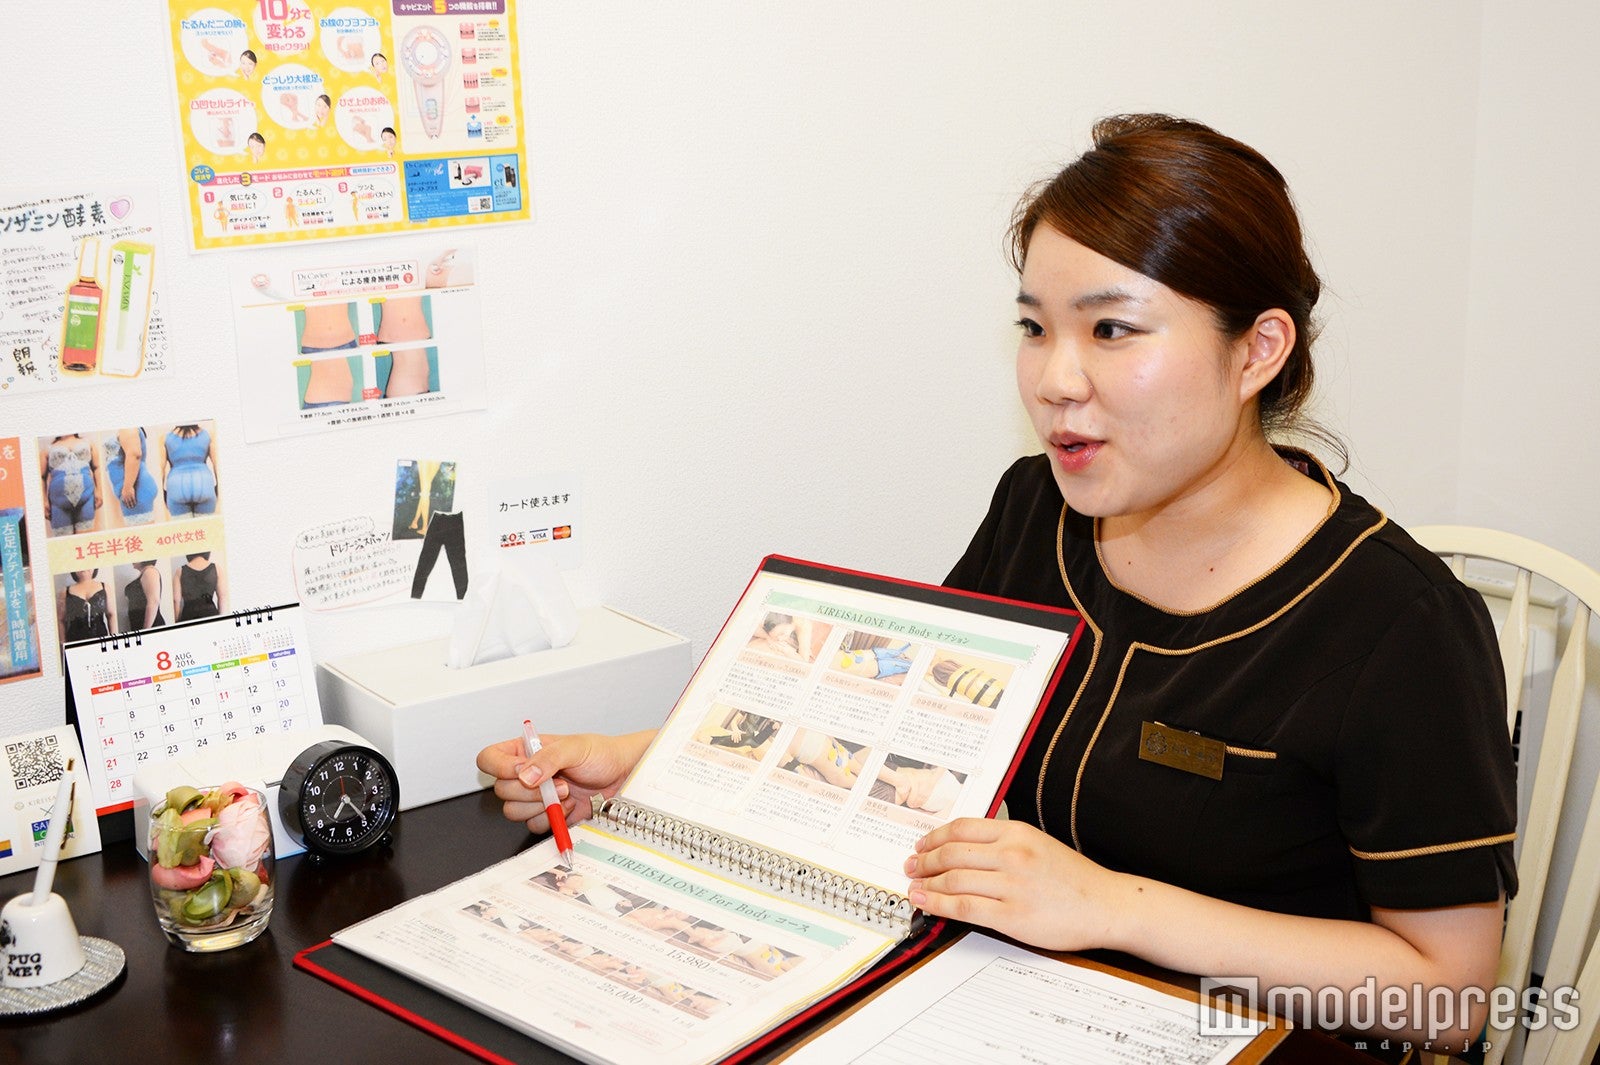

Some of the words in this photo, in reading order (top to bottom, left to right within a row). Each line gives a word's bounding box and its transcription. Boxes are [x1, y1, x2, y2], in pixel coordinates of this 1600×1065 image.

[266, 24, 306, 39] 変わる
[230, 192, 258, 202] 気になる
[296, 188, 322, 197] たるんだ
[500, 493, 571, 512] カード使えます
[75, 536, 144, 560] 1年半後
[156, 529, 207, 546] 40代女性
[817, 605, 886, 628] KIREISALONE
[888, 622, 906, 632] For
[908, 626, 932, 639] Body
[936, 632, 970, 645] オプション
[156, 651, 172, 670] 8
[174, 652, 192, 662] AUG
[176, 659, 196, 668] 2016
[156, 684, 162, 692] 2
[98, 717, 104, 725] 7
[129, 710, 135, 718] 8
[160, 704, 166, 712] 9
[190, 697, 200, 706] 10
[220, 691, 228, 700] 11
[248, 685, 258, 693] 12
[276, 679, 286, 688] 13
[104, 737, 114, 746] 14
[134, 731, 144, 740] 15
[164, 724, 174, 732] 16
[194, 718, 204, 726] 17
[223, 712, 233, 720] 18
[252, 705, 262, 714] 19
[279, 699, 289, 708] 20
[106, 758, 118, 768] 21
[137, 752, 148, 760] 22
[168, 744, 178, 754] 23
[197, 738, 208, 747] 24
[226, 732, 236, 740] 25
[254, 726, 265, 734] 26
[282, 719, 292, 728] 27
[334, 762, 344, 771] 12
[353, 762, 358, 770] 1
[320, 771, 328, 780] 11
[366, 770, 372, 780] 2
[110, 779, 122, 789] 28
[310, 787, 320, 796] 10
[372, 786, 378, 794] 3
[309, 804, 316, 814] 9
[370, 804, 376, 812] 4
[317, 820, 324, 828] 8
[329, 828, 336, 837] 7
[346, 828, 352, 836] 6
[607, 854, 706, 897] KIREISALONE
[709, 894, 733, 907] For
[735, 904, 770, 922] Body
[776, 917, 812, 933] コース
[8, 954, 42, 964] PUG
[8, 964, 42, 977] ME?
